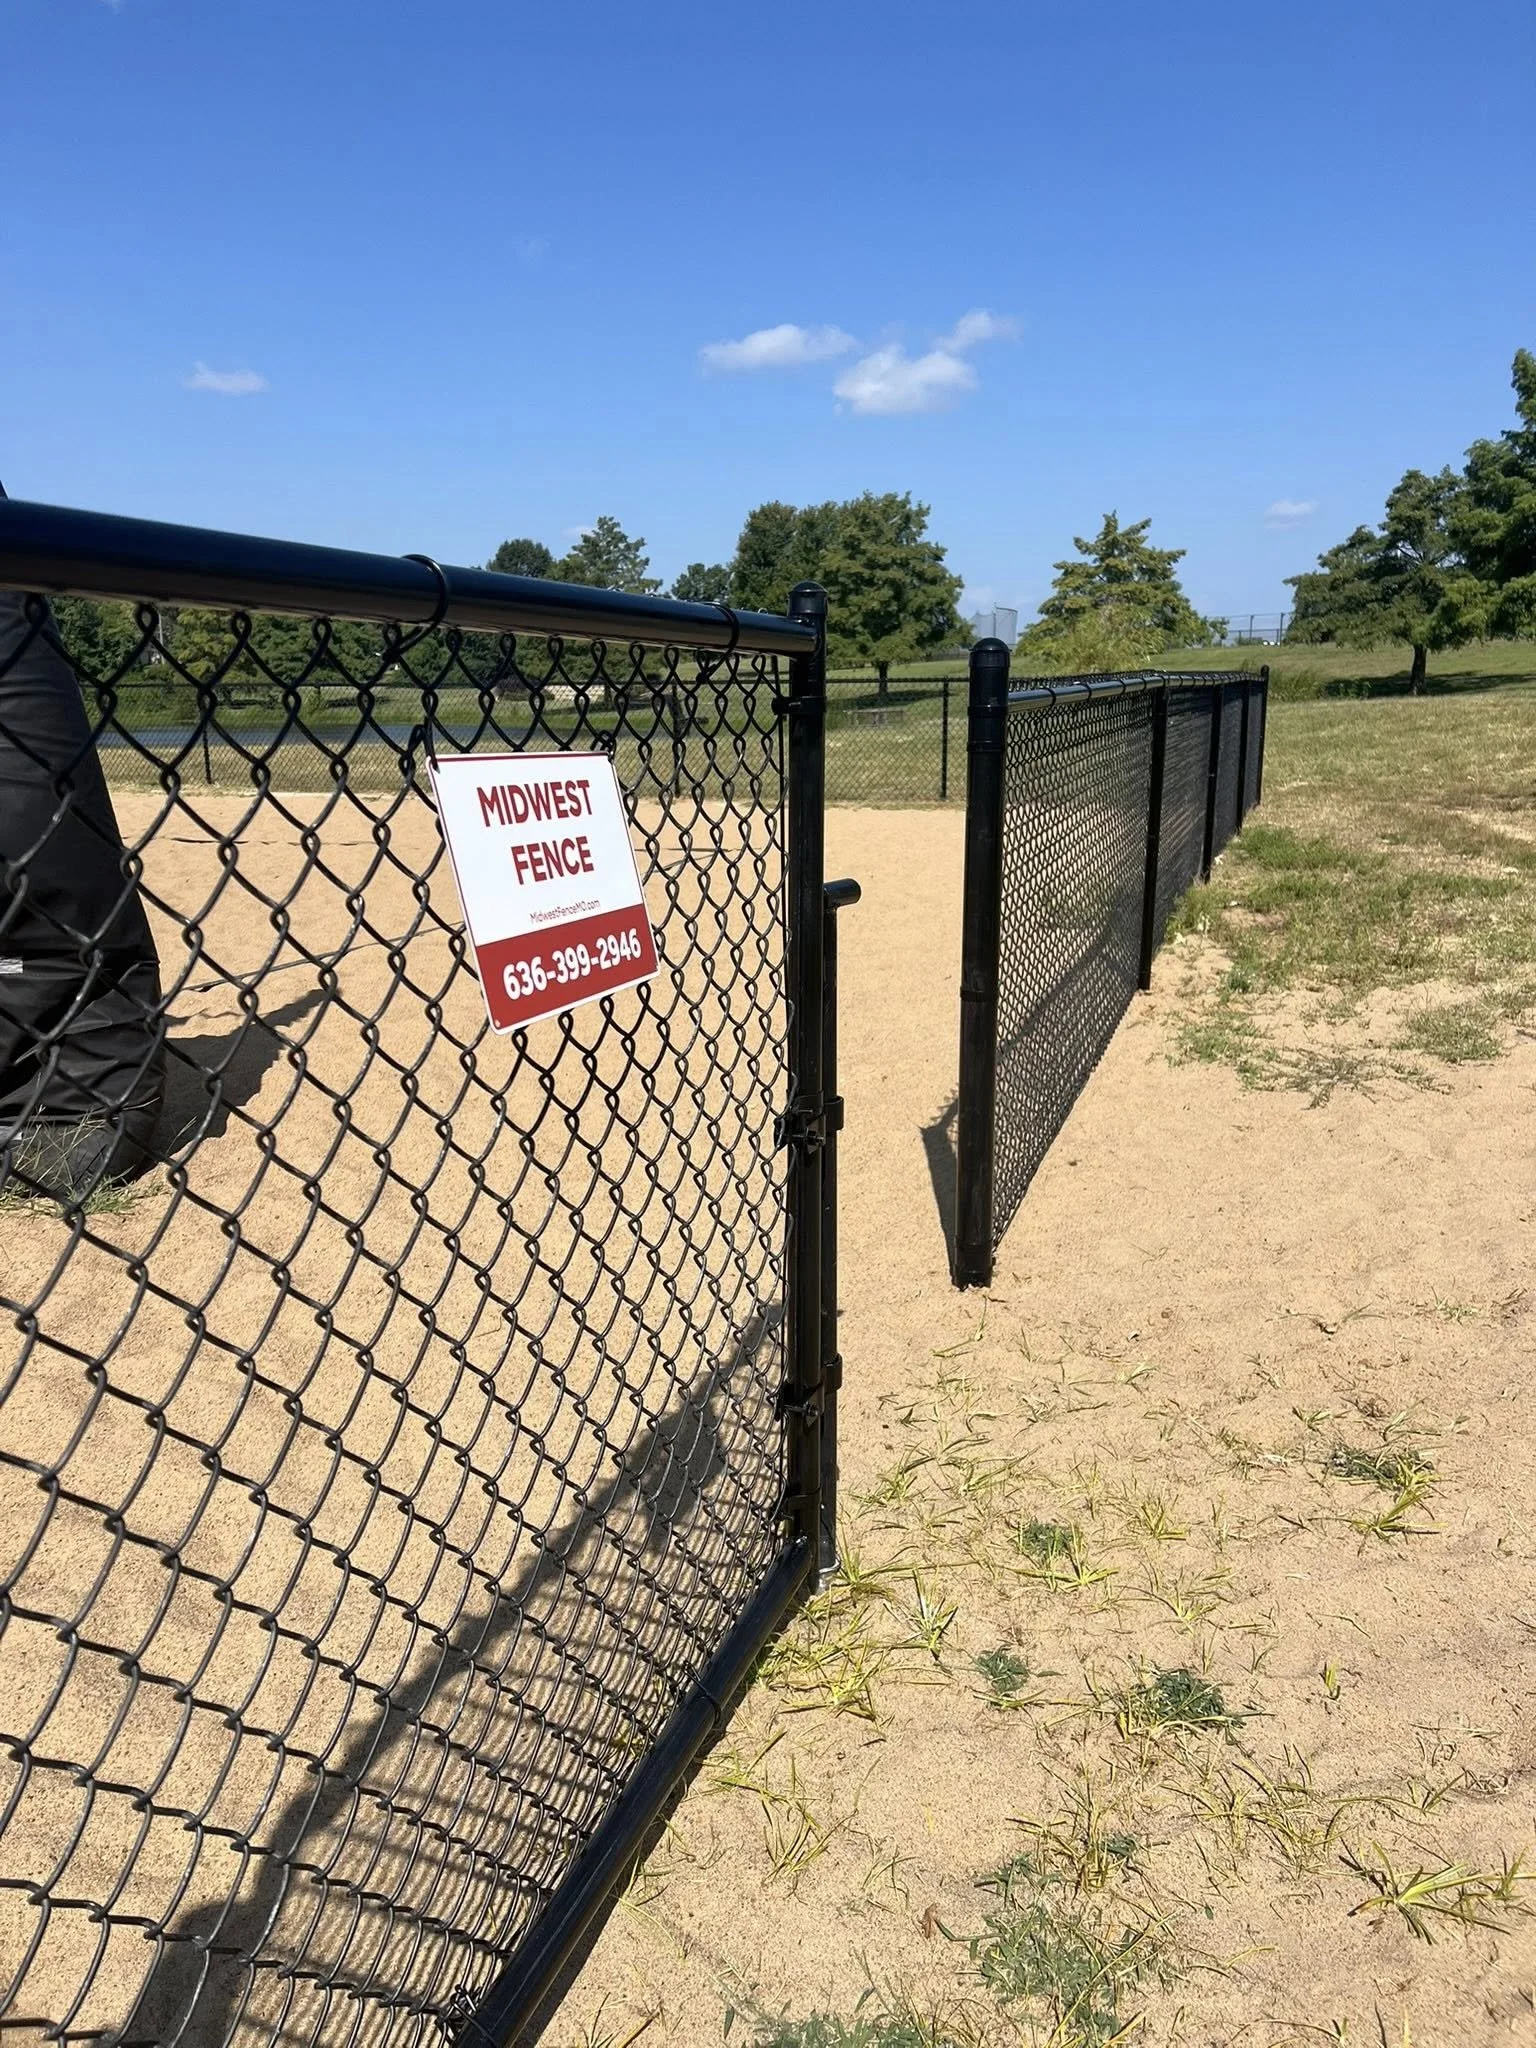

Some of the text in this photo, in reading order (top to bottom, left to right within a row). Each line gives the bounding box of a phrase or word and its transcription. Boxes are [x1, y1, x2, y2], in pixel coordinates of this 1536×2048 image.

[476, 780, 593, 827] MIDWEST
[510, 836, 595, 885] FENCE
[503, 928, 642, 1000] 636-399-2946
